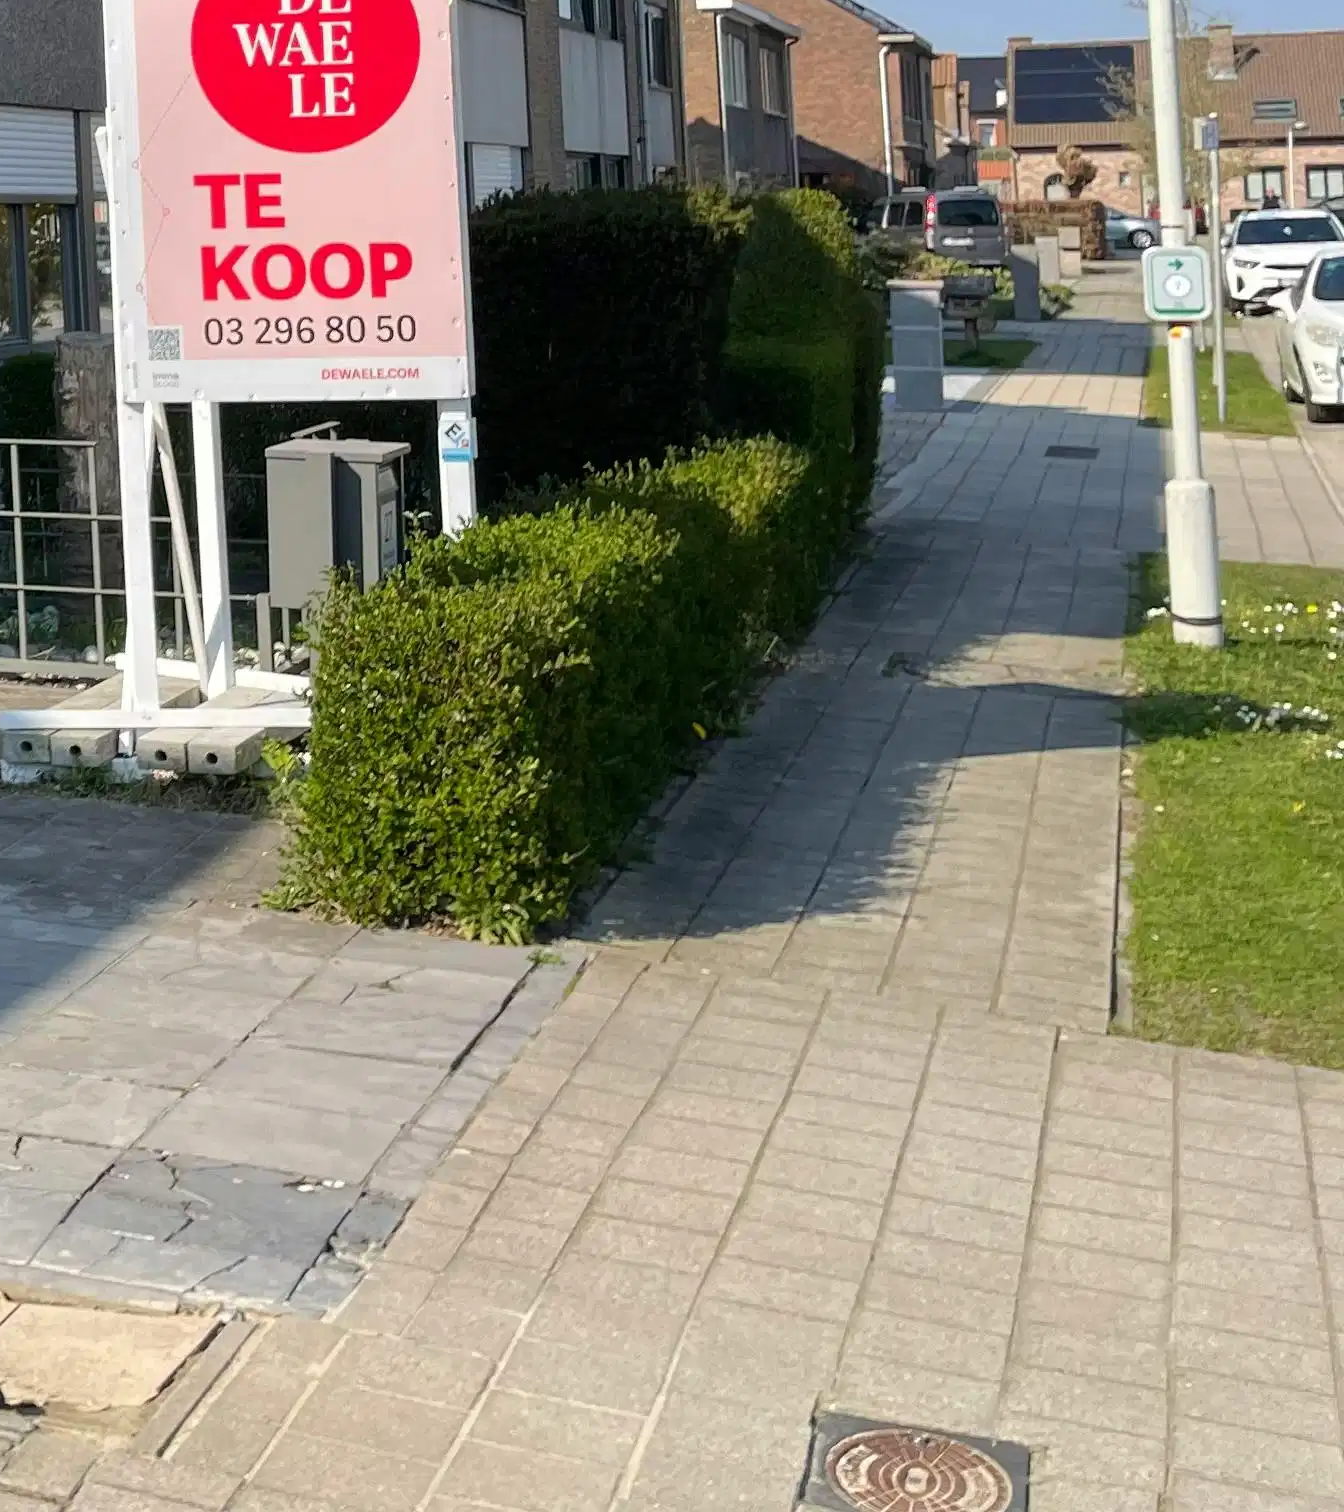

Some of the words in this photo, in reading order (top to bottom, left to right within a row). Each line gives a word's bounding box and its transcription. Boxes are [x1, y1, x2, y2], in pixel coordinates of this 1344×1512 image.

[232, 20, 354, 67] WAE
[288, 72, 356, 118] LE
[193, 173, 285, 229] TE
[200, 242, 413, 302] KOOP
[204, 318, 244, 345] 03
[254, 316, 315, 345] 296
[325, 315, 366, 343] 80
[376, 314, 417, 342] 50
[320, 367, 420, 381] DEWAELE.COM
